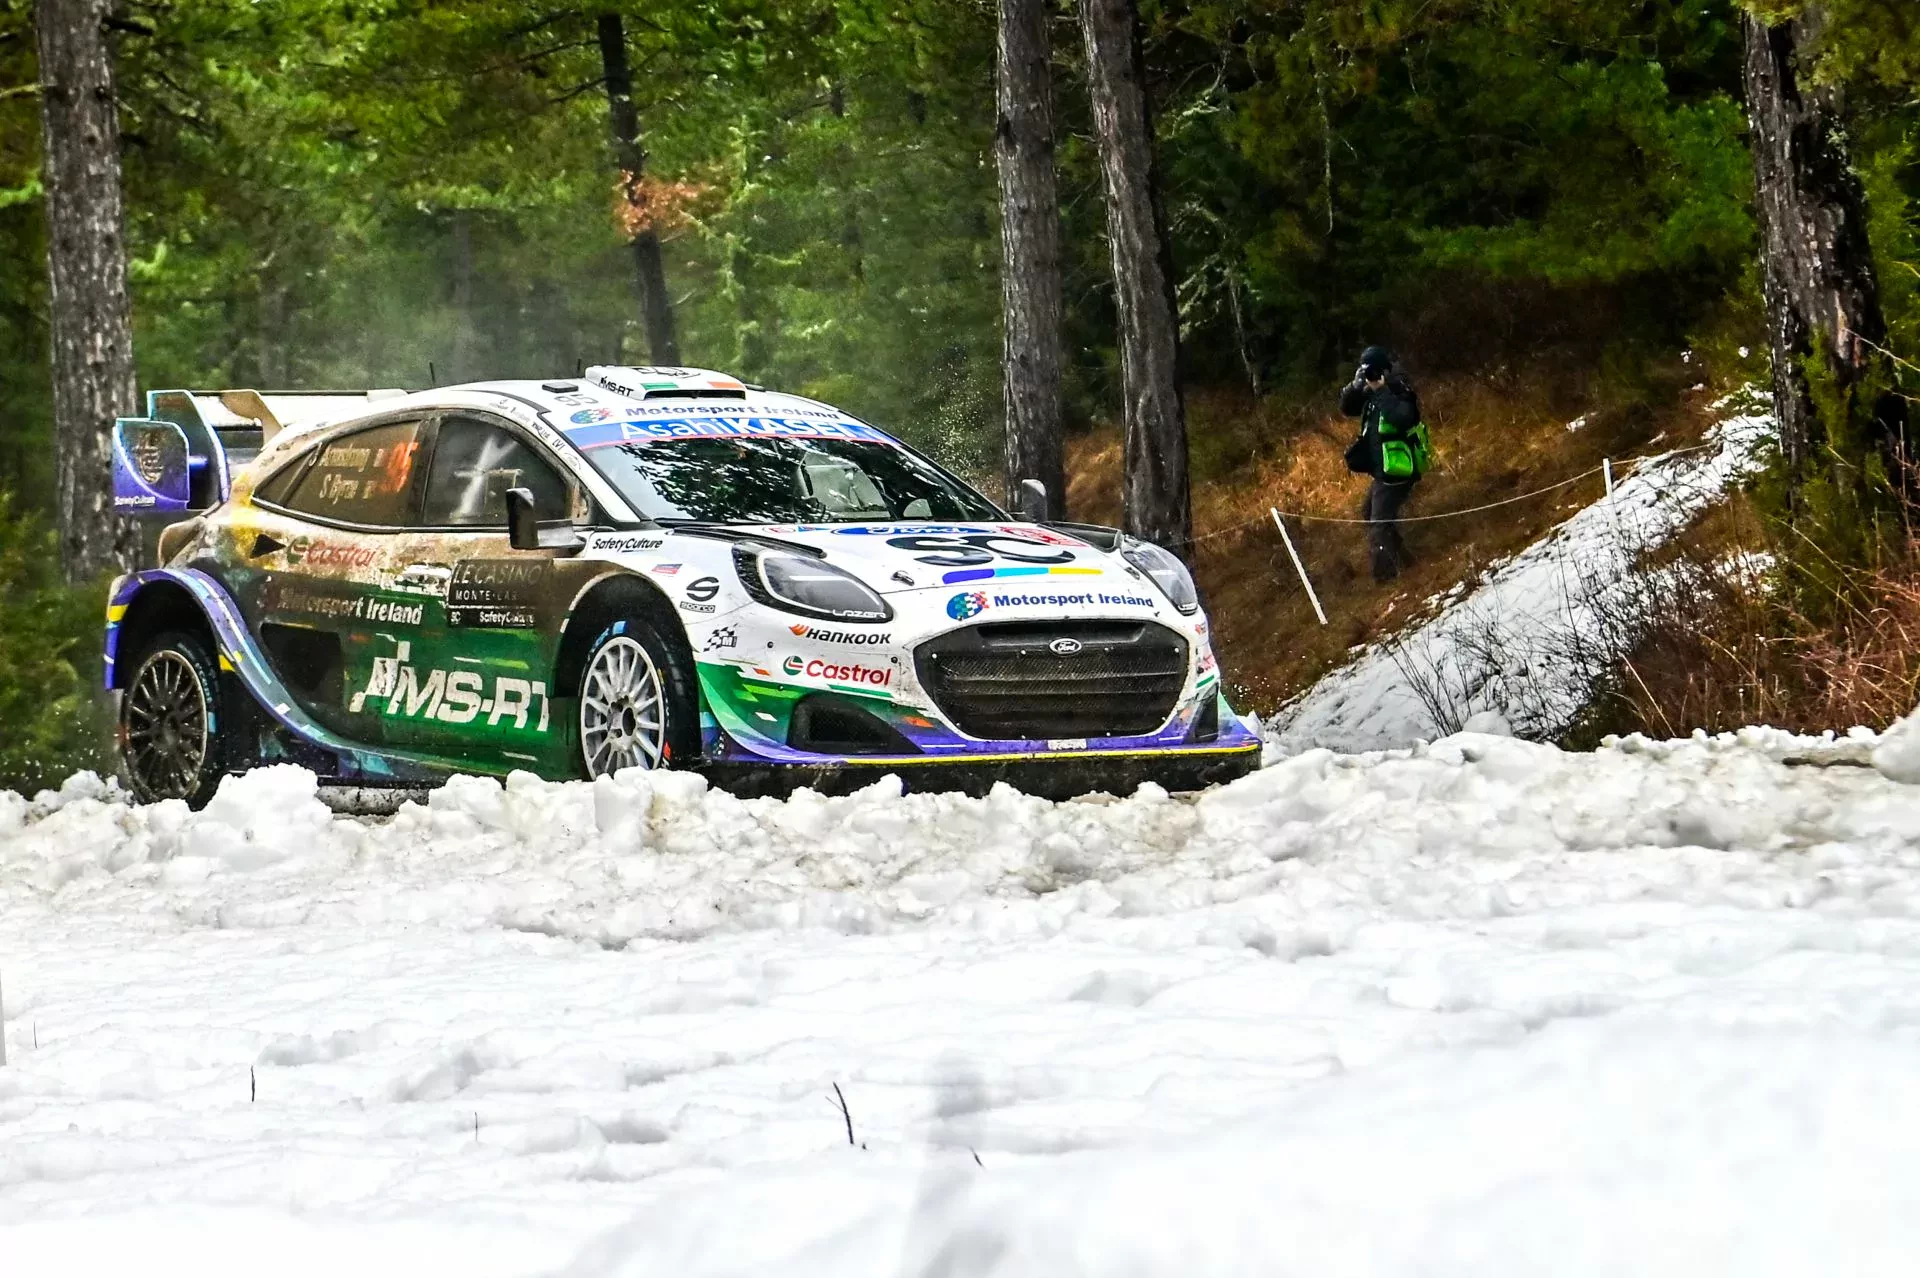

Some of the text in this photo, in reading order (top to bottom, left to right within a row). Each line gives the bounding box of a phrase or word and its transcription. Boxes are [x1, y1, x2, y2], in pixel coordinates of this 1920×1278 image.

[625, 406, 840, 419] Motorsport Ireland
[592, 537, 663, 553] SafetyCulture
[886, 535, 1077, 567] SC
[994, 592, 1154, 608] Motorsport Ireland
[366, 599, 424, 625] Ireland
[832, 609, 887, 619] LAZER
[806, 659, 892, 686] Castrol
